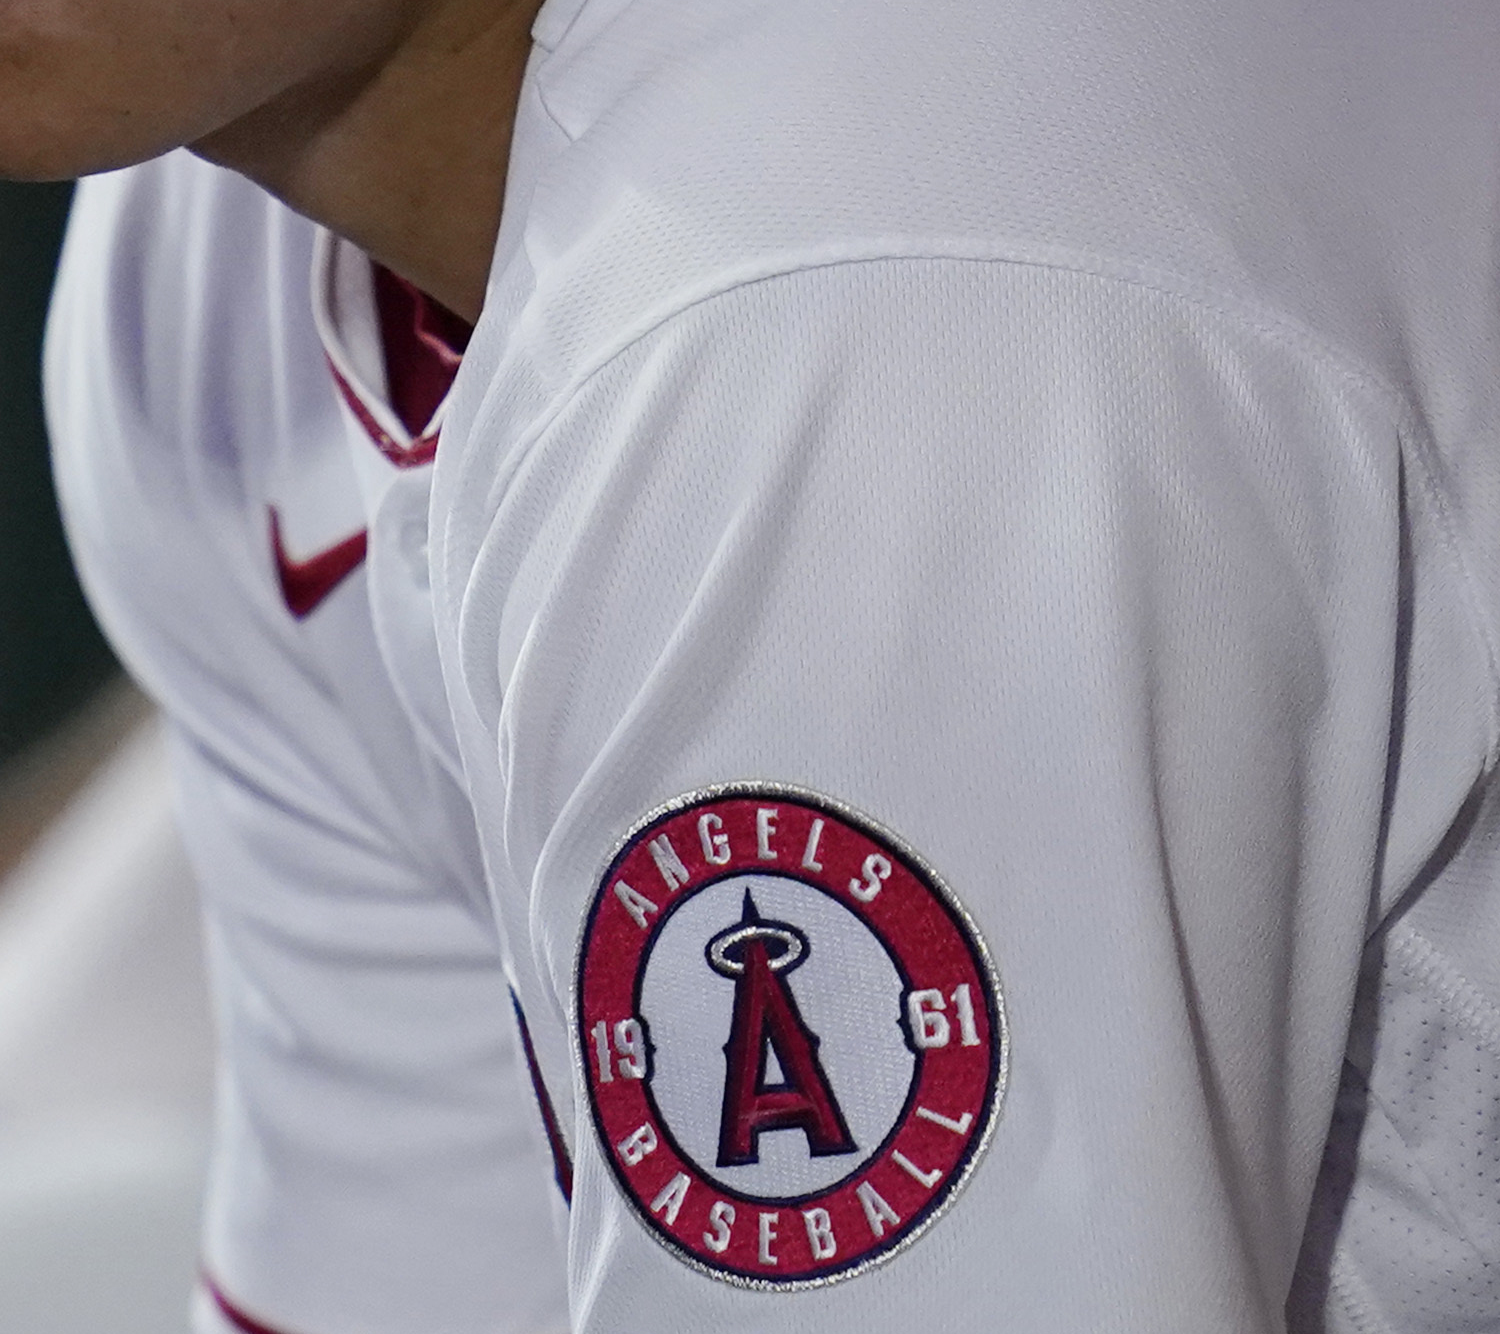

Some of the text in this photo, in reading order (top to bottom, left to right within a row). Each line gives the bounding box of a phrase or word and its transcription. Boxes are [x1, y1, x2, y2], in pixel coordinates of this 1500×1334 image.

[613, 807, 893, 929] ANGELS
[590, 983, 981, 1083] 19 61
[704, 886, 859, 1168] A
[617, 1105, 974, 1266] BASEBALL
